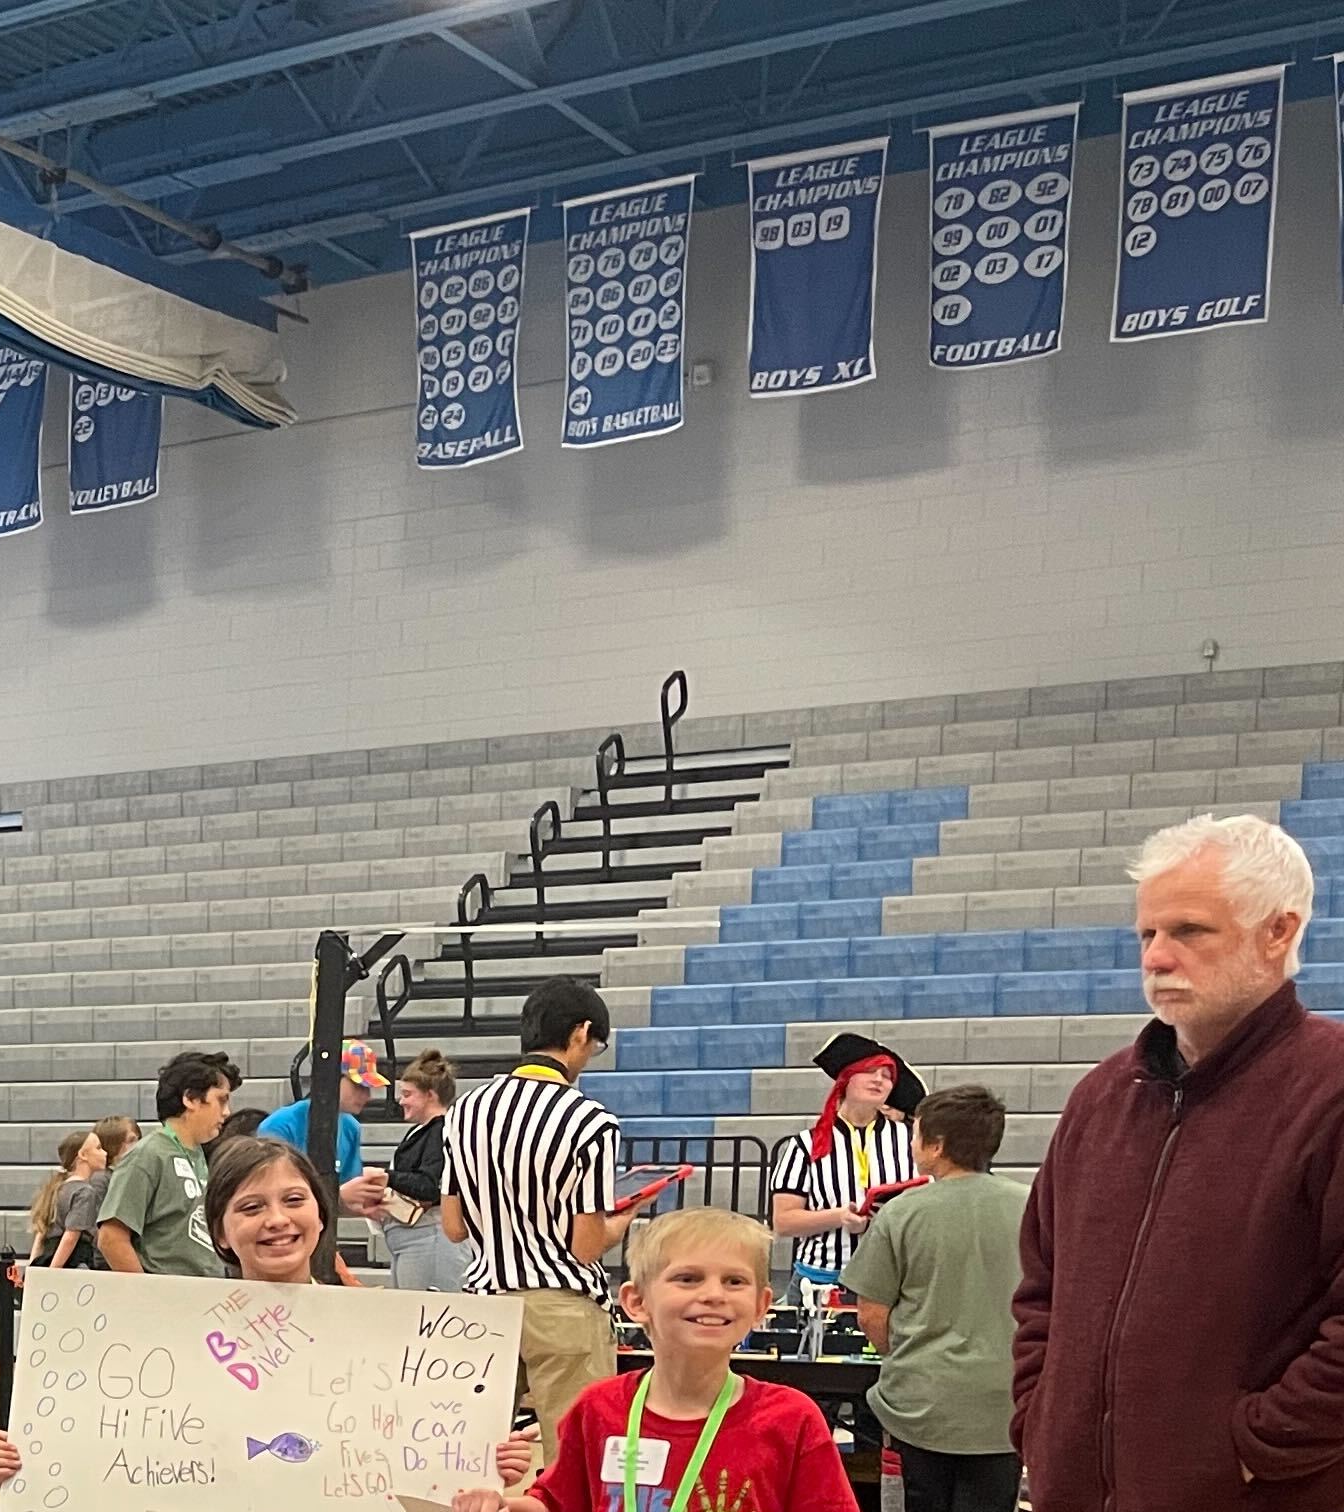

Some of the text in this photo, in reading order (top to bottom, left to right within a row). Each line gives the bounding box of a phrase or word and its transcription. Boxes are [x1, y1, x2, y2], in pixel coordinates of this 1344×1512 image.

[1155, 89, 1249, 123] LEAGUE
[959, 125, 1047, 156] LEAGUE
[1129, 109, 1272, 149] CHAMPIONS
[776, 156, 859, 189] LEAGUE
[936, 143, 1069, 182] CHAMPIONS
[1134, 143, 1265, 180] 73 74 75 76
[754, 176, 882, 212] CHAMPIONS
[989, 188, 1011, 203] 82
[1036, 180, 1058, 197] 92
[1131, 180, 1264, 215] 78 81 00 07
[590, 193, 668, 226] LEAGUE
[792, 219, 812, 237] 03
[825, 213, 843, 231] 19
[434, 224, 506, 254] LEAGUE
[569, 213, 686, 251] CHAMPIONS
[943, 215, 1057, 247] 99 00 01
[1129, 231, 1152, 250] 12
[420, 240, 522, 276] CHAMPIONS
[572, 248, 651, 275] 73 78
[939, 252, 1054, 283] 02 03 17
[634, 282, 652, 296] 87
[446, 309, 490, 328] 91 92
[602, 315, 651, 336] 10 11
[940, 302, 960, 319] 18
[1121, 294, 1261, 333] BOYS GOLF
[446, 342, 488, 361] 15 16
[601, 341, 678, 369] 19 20 23
[446, 371, 489, 391] 19 21
[751, 365, 823, 390] BOYS
[445, 410, 462, 424] 24
[567, 401, 681, 437] BOYS BASKETBALL
[203, 1288, 252, 1324] THE
[206, 1304, 292, 1363] Battle
[98, 1343, 175, 1399] GO
[227, 1321, 314, 1391] Diver!
[100, 1404, 129, 1438] Hi
[404, 1446, 428, 1471] Do
